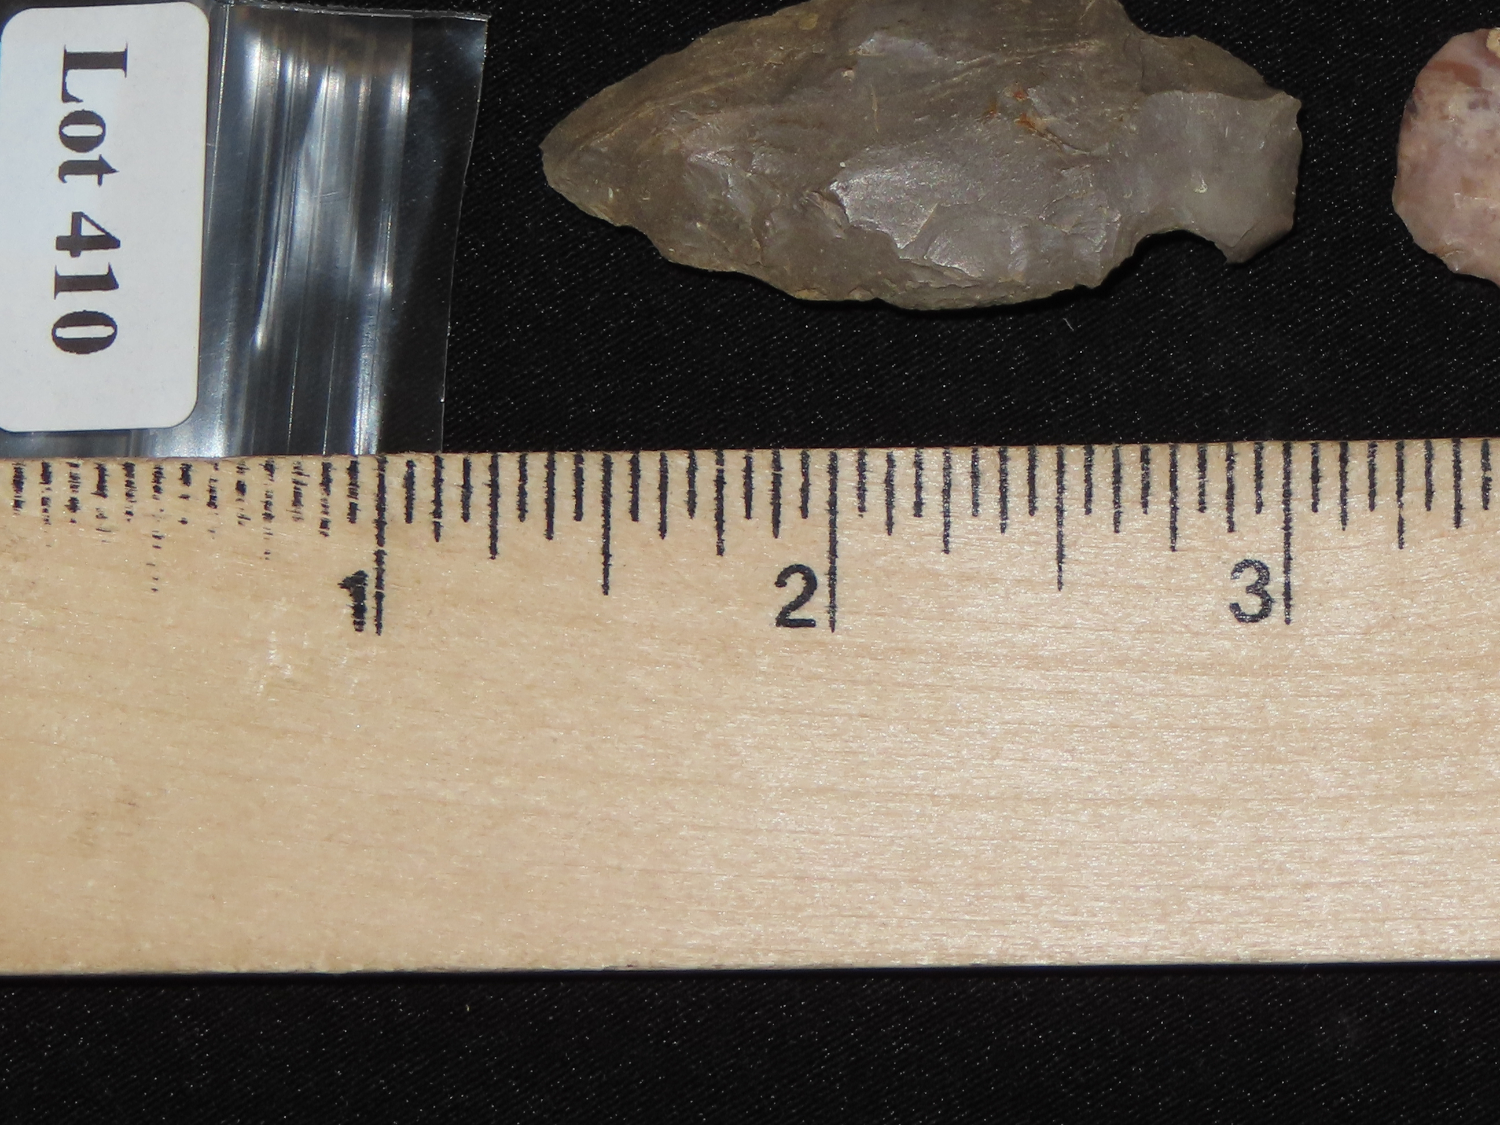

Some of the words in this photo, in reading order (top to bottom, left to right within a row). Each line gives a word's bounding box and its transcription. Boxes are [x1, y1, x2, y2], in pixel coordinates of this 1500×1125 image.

[58, 43, 129, 186] Lot
[51, 211, 121, 356] 410
[339, 570, 368, 633] 1
[774, 563, 819, 629] 2
[1229, 559, 1274, 623] 3
